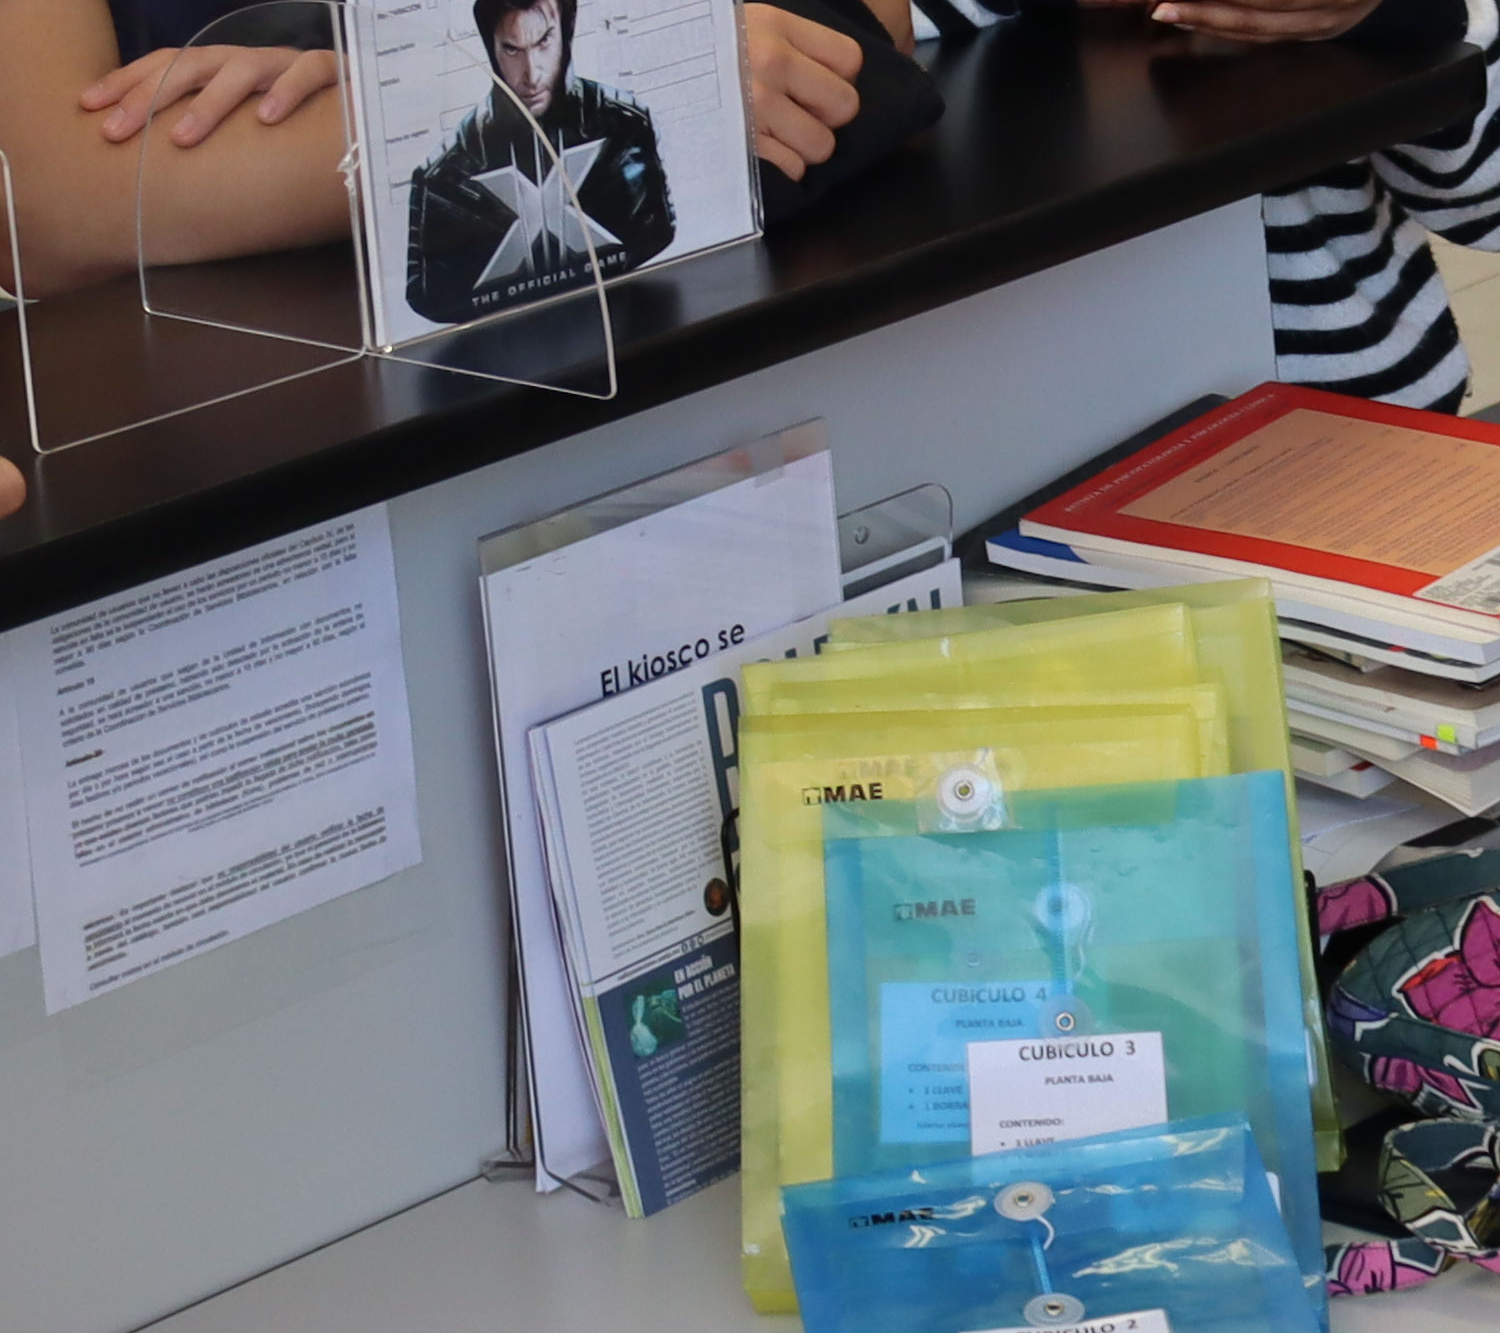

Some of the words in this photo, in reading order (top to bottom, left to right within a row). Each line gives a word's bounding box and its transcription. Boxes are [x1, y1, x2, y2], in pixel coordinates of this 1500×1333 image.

[471, 292, 500, 308] THE
[507, 269, 577, 298] OFFICIAL
[599, 666, 621, 698] El
[627, 637, 710, 687] kiosco
[717, 624, 746, 651] se
[822, 782, 884, 804] MAE
[914, 897, 976, 919] MAE
[677, 982, 695, 1001] POR
[694, 978, 704, 993] EL
[1035, 986, 1048, 1001] 4
[955, 1019, 995, 1029] PLANTA
[1124, 1039, 1136, 1055] 3
[1044, 1075, 1086, 1085] PLANTA
[1087, 1073, 1114, 1084] BAJA
[999, 1118, 1065, 1129] CONTENIDO:
[1126, 1319, 1139, 1331] 2
